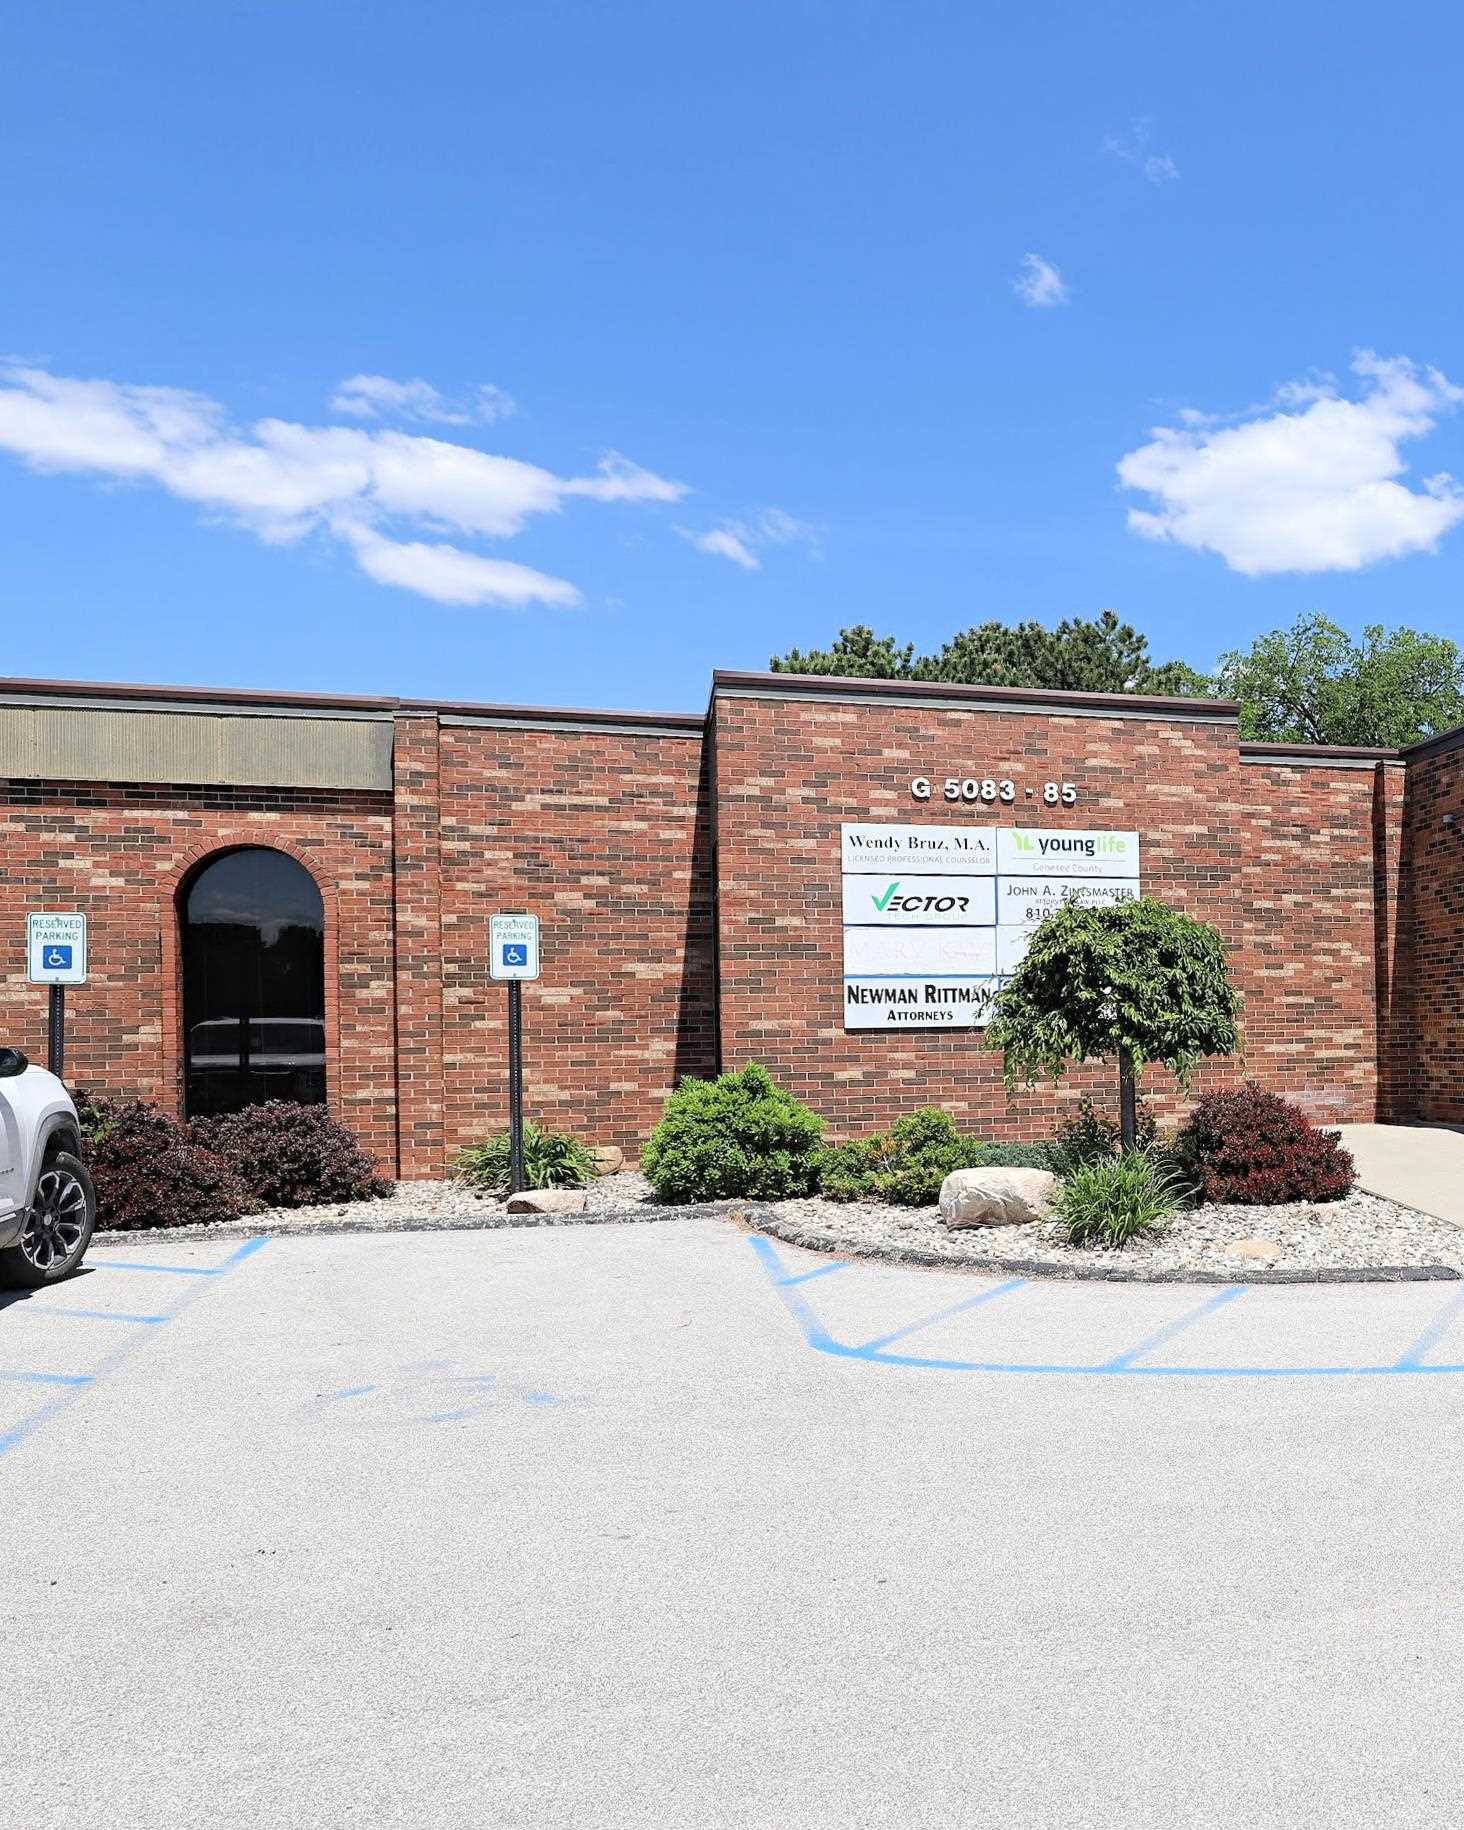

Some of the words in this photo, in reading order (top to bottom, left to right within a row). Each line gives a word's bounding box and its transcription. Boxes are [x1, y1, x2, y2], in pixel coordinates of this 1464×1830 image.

[911, 776, 931, 798] G
[944, 778, 1016, 801] 5083
[1043, 782, 1077, 803] 85
[849, 835, 903, 852] Wendy
[908, 836, 949, 851] Bruz,
[953, 837, 991, 851] M.A.
[887, 855, 944, 864] PROFESSIONAL
[1072, 863, 1103, 874] County
[1007, 884, 1038, 897] JOHN
[1043, 885, 1056, 897] A.
[32, 919, 82, 929] RESERVED
[493, 920, 534, 930] RESERVED
[35, 931, 79, 941] PARKING
[496, 932, 532, 940] PARKING
[847, 985, 918, 1004] NEWMAN
[925, 984, 991, 1003] RITTMAN
[887, 1010, 954, 1021] ATTORNEYS
